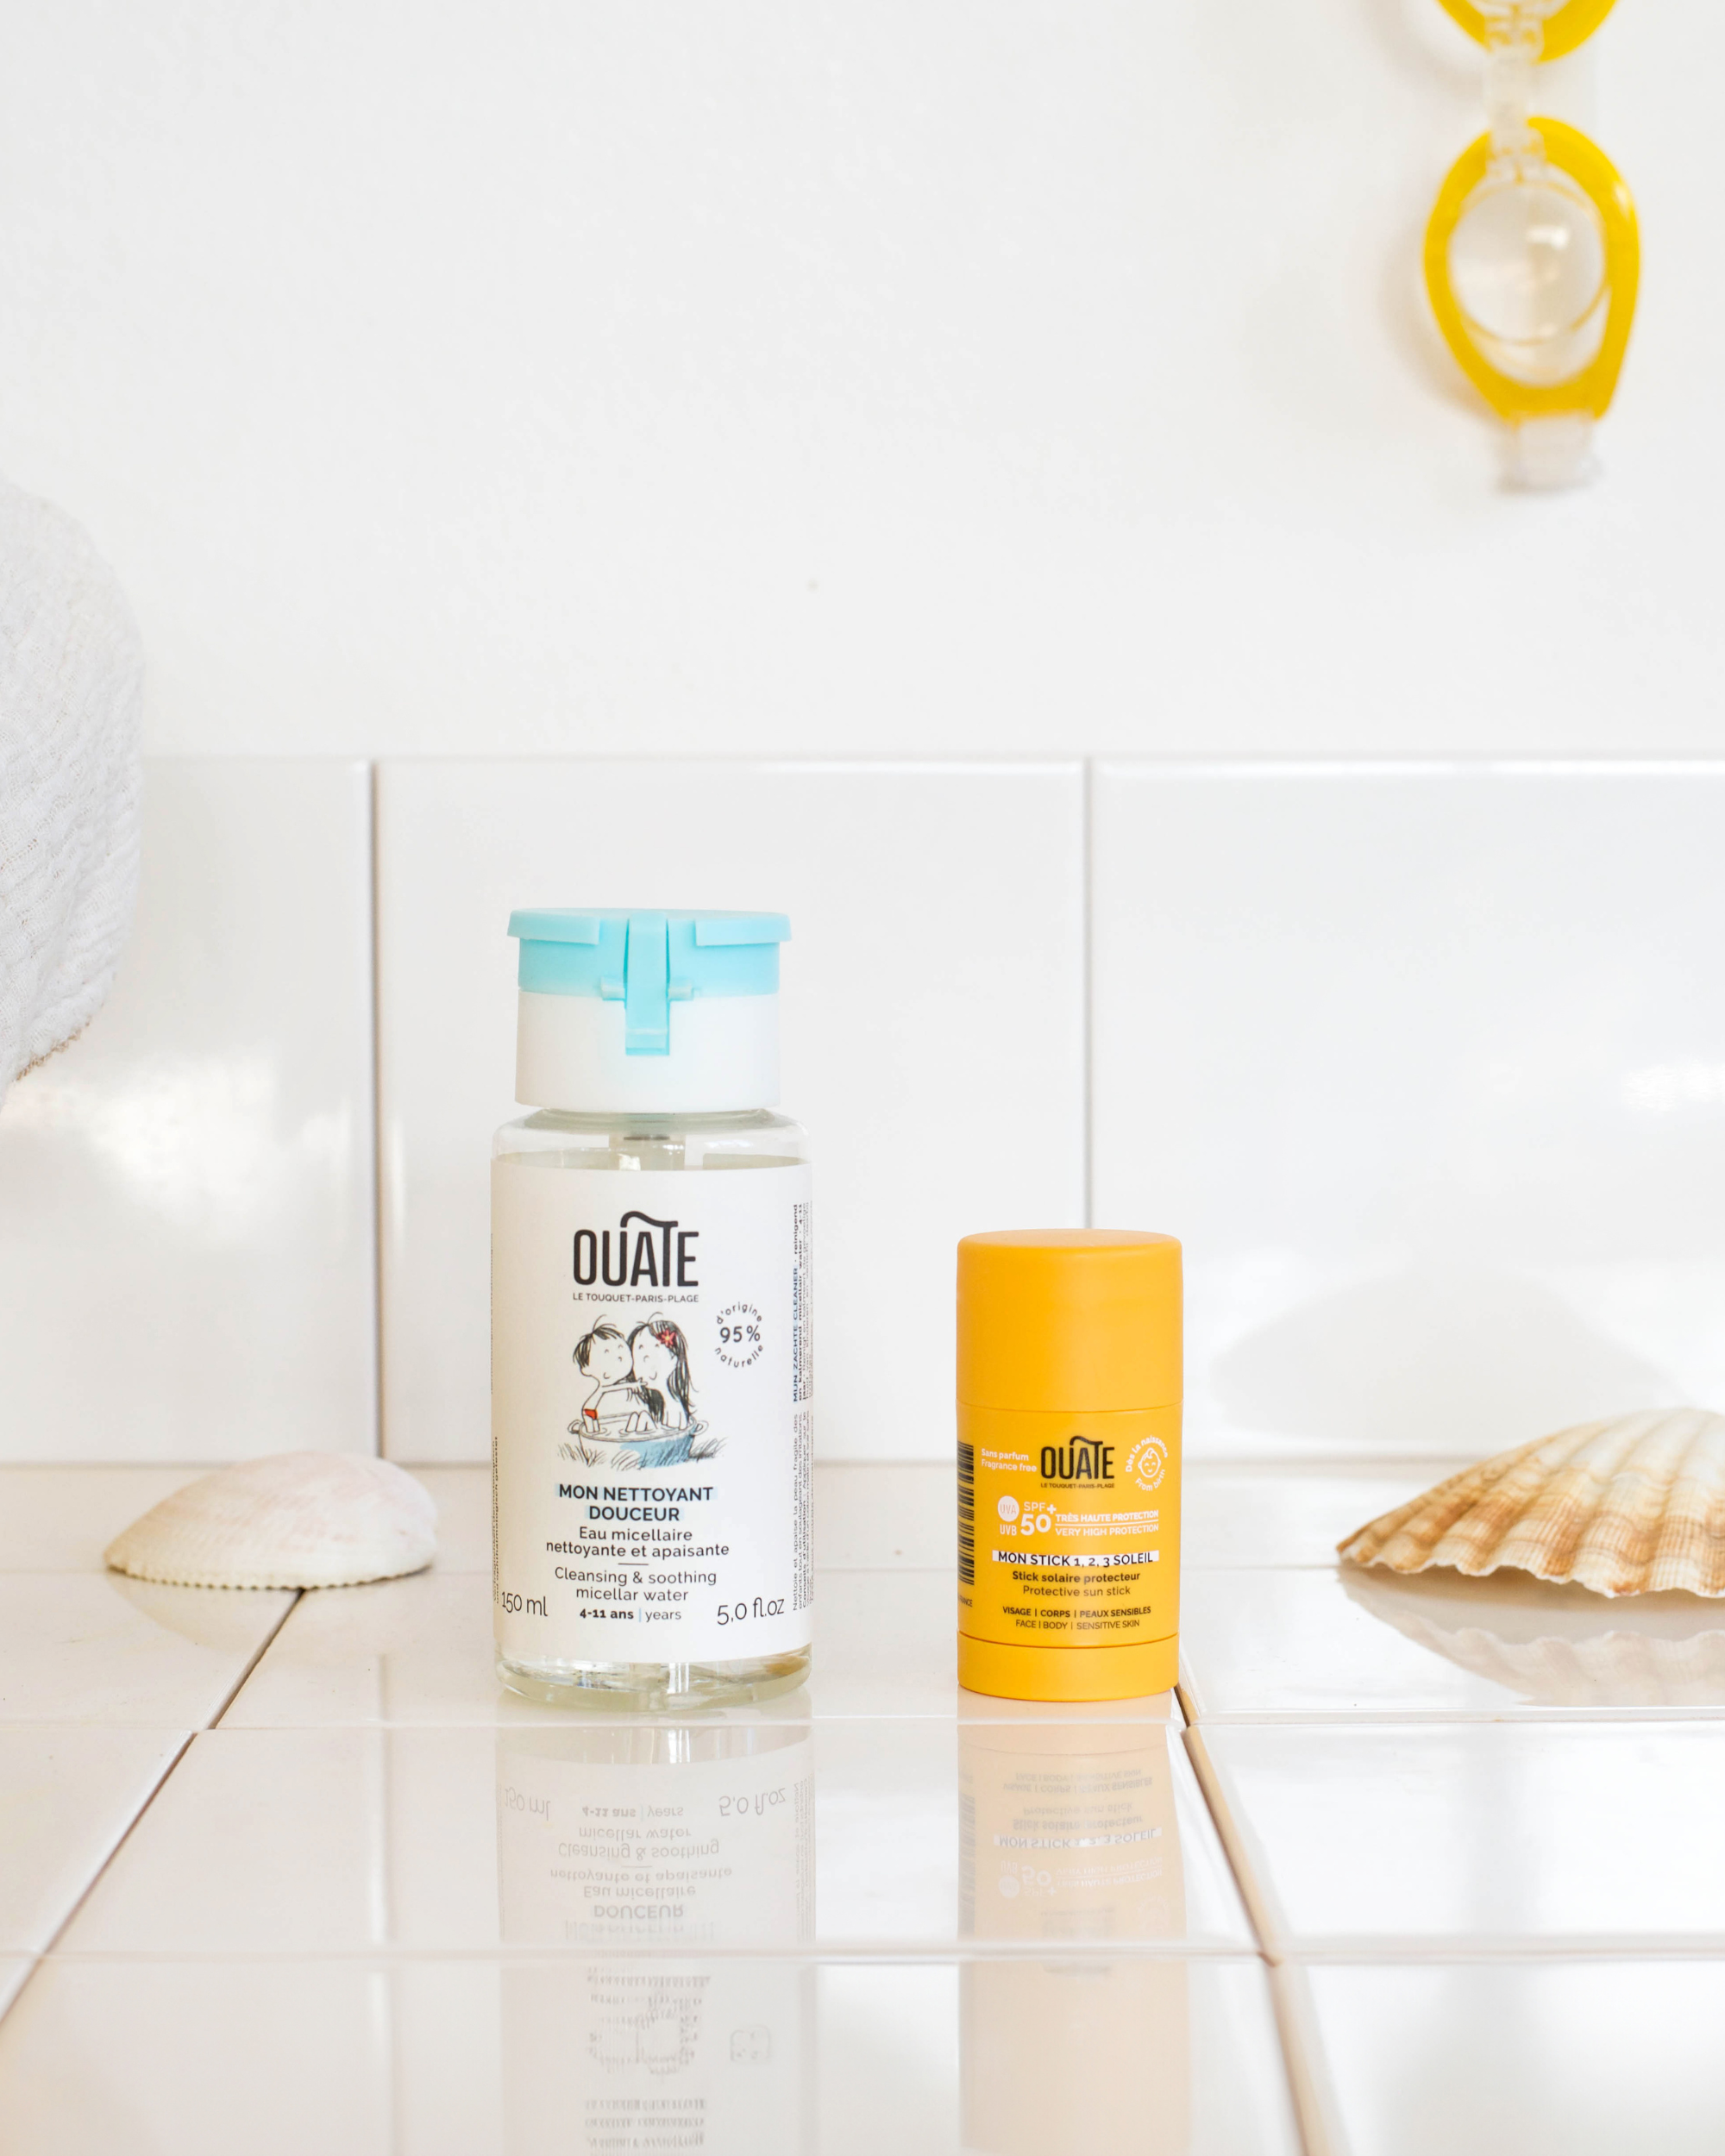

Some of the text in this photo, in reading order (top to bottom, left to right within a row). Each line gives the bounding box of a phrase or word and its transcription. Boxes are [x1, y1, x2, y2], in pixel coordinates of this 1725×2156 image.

[573, 1292, 699, 1303] LE TOUQUET-PARIS-PLAGE
[716, 1301, 762, 1325] d'origine
[714, 1344, 763, 1369] naturelle
[981, 1448, 1029, 1462] Sans parfum
[981, 1458, 1037, 1472] Fragrance free
[1134, 1469, 1165, 1491] From birth
[559, 1483, 714, 1502] MON NETTOYANT
[589, 1506, 680, 1521] DOUCEUR
[1000, 1501, 1046, 1514] UVA SPF
[1056, 1509, 1159, 1522] TRÈS HAUTE PROTECTION
[580, 1526, 693, 1542] Eau micellaire
[1000, 1524, 1017, 1536] UVB
[1055, 1524, 1159, 1537] VERY HIGH PROTECTION
[546, 1540, 730, 1561] nettoyante et apaisante
[998, 1551, 1027, 1564] MON
[1030, 1553, 1070, 1566] STICK
[1103, 1557, 1110, 1568] 3
[1113, 1551, 1153, 1564] SOLEIL
[555, 1566, 717, 1587] Cleansing & soothing
[1013, 1570, 1140, 1584] Stick solaire protecteur
[575, 1587, 689, 1601] micellar water
[1023, 1585, 1131, 1596] Protective sun stick
[501, 1591, 549, 1617] 150 ml
[752, 1596, 785, 1619] fl.oz
[580, 1608, 681, 1622] 4-11 ans years
[1002, 1606, 1151, 1618] VISAGE CORPS PEAUX SENSIBLES
[1015, 1619, 1140, 1630] FACE BODY SENSITIVE SKIN
